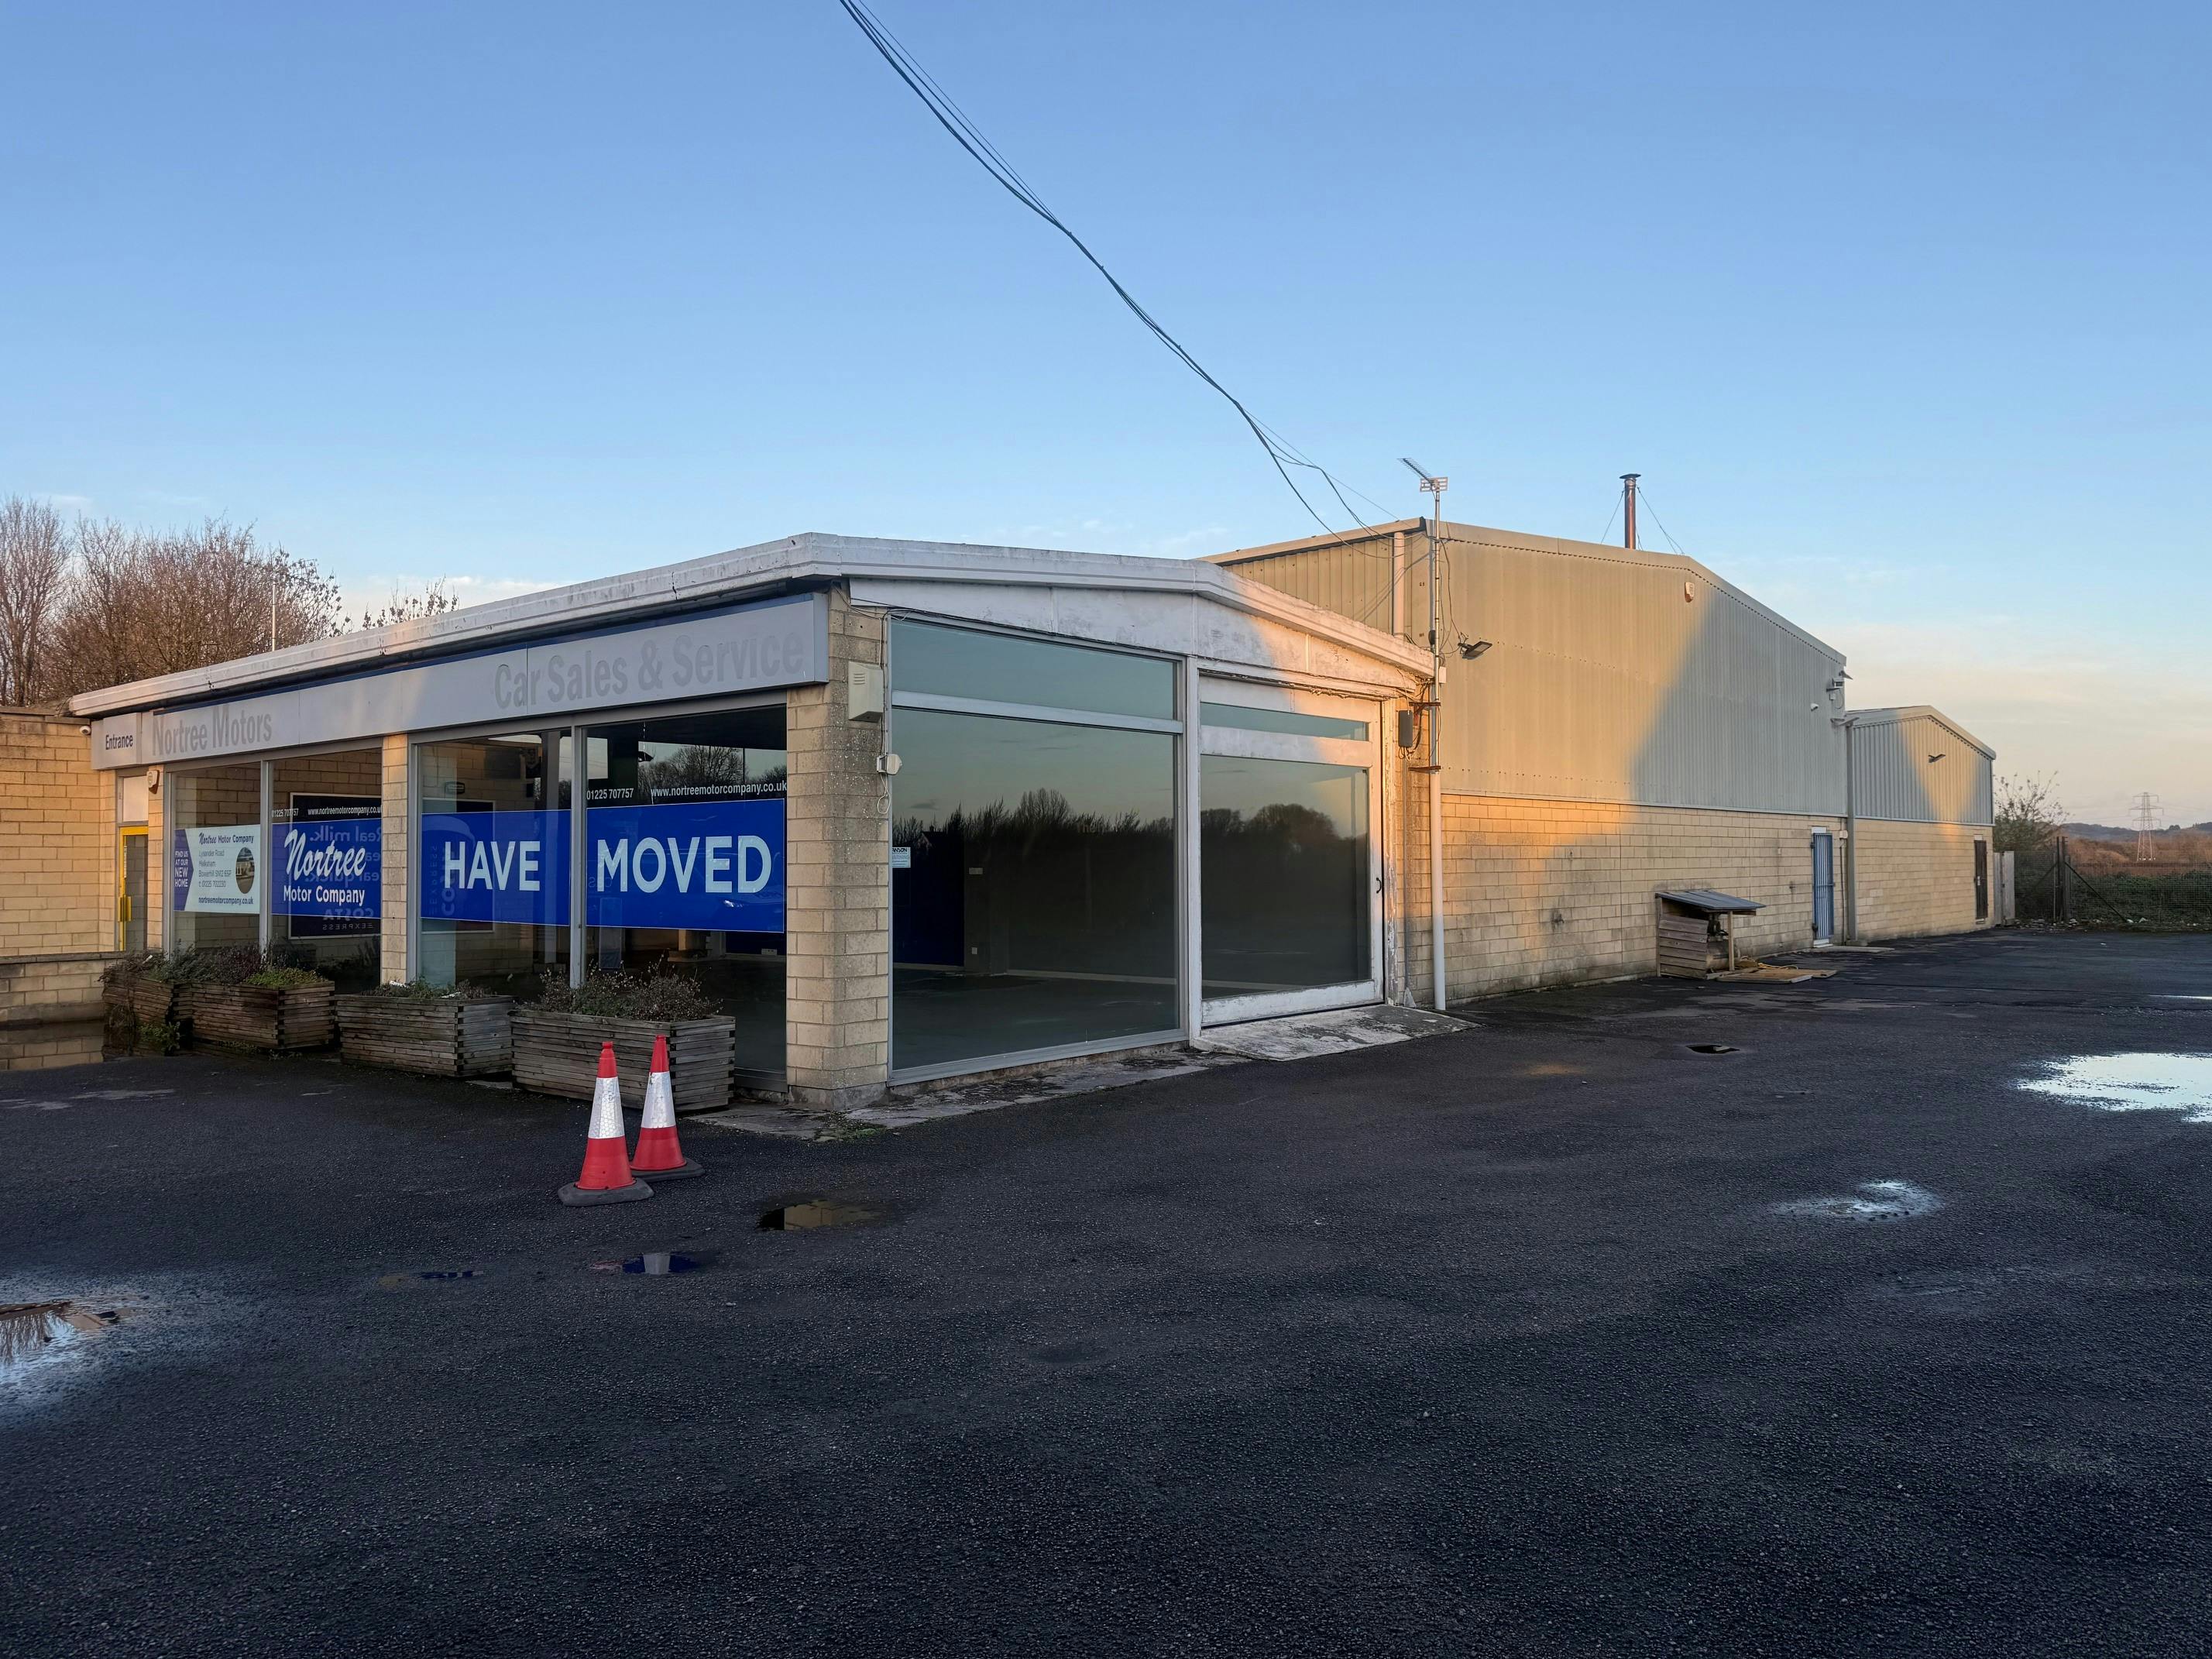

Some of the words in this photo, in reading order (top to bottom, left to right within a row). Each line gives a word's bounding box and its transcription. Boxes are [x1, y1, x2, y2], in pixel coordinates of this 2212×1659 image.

[494, 664, 541, 709] Car
[547, 650, 628, 703] Sales
[637, 639, 664, 692] &
[672, 632, 805, 688] Service
[152, 714, 208, 756] Nortree
[212, 704, 272, 749] Motors
[105, 734, 133, 750] Entrance
[586, 788, 608, 800] 01225
[609, 788, 634, 799] 707757
[651, 780, 787, 797] www.nortreemotorcompany.co.uk
[307, 805, 383, 816] www.nortreemotorcompany.co.u
[218, 835, 231, 843] Motor
[232, 834, 254, 844] Company
[283, 829, 366, 881] Nortree
[174, 867, 188, 878] NEW
[444, 840, 541, 891] HAVE
[597, 835, 772, 894] MOVED
[174, 878, 188, 888] HOME
[198, 896, 254, 905] nortreemotorcompany.co.uk
[283, 884, 311, 902] Motor
[315, 885, 365, 906] Company
